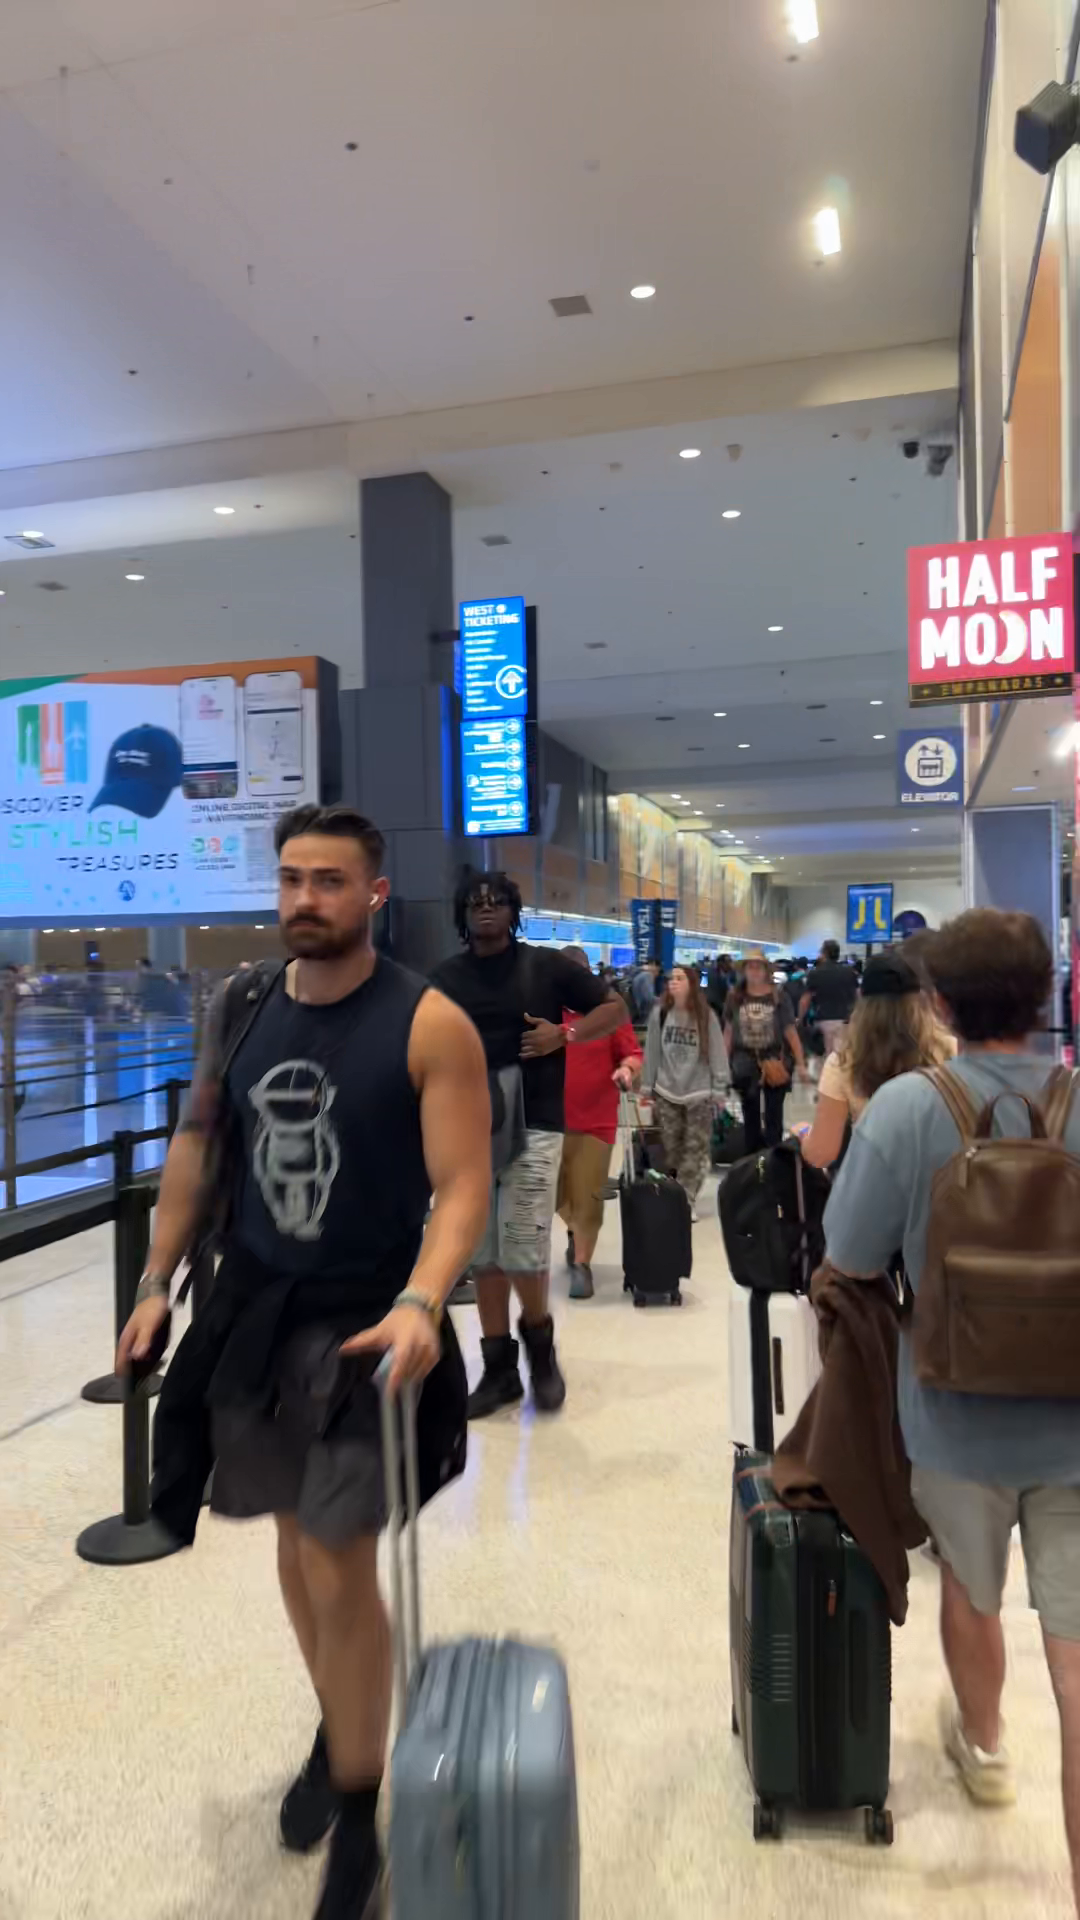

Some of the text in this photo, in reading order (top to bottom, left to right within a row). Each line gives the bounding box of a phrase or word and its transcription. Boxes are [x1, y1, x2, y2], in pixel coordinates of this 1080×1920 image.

[928, 546, 1059, 609] HALF
[463, 604, 496, 616] WEST
[463, 613, 521, 627] TICKETING
[941, 676, 1043, 696] EMPANADAS
[9, 819, 138, 849] STYLISH
[55, 852, 179, 873] TREASURES
[637, 904, 651, 935] TSA
[663, 1025, 698, 1047] NIKE
